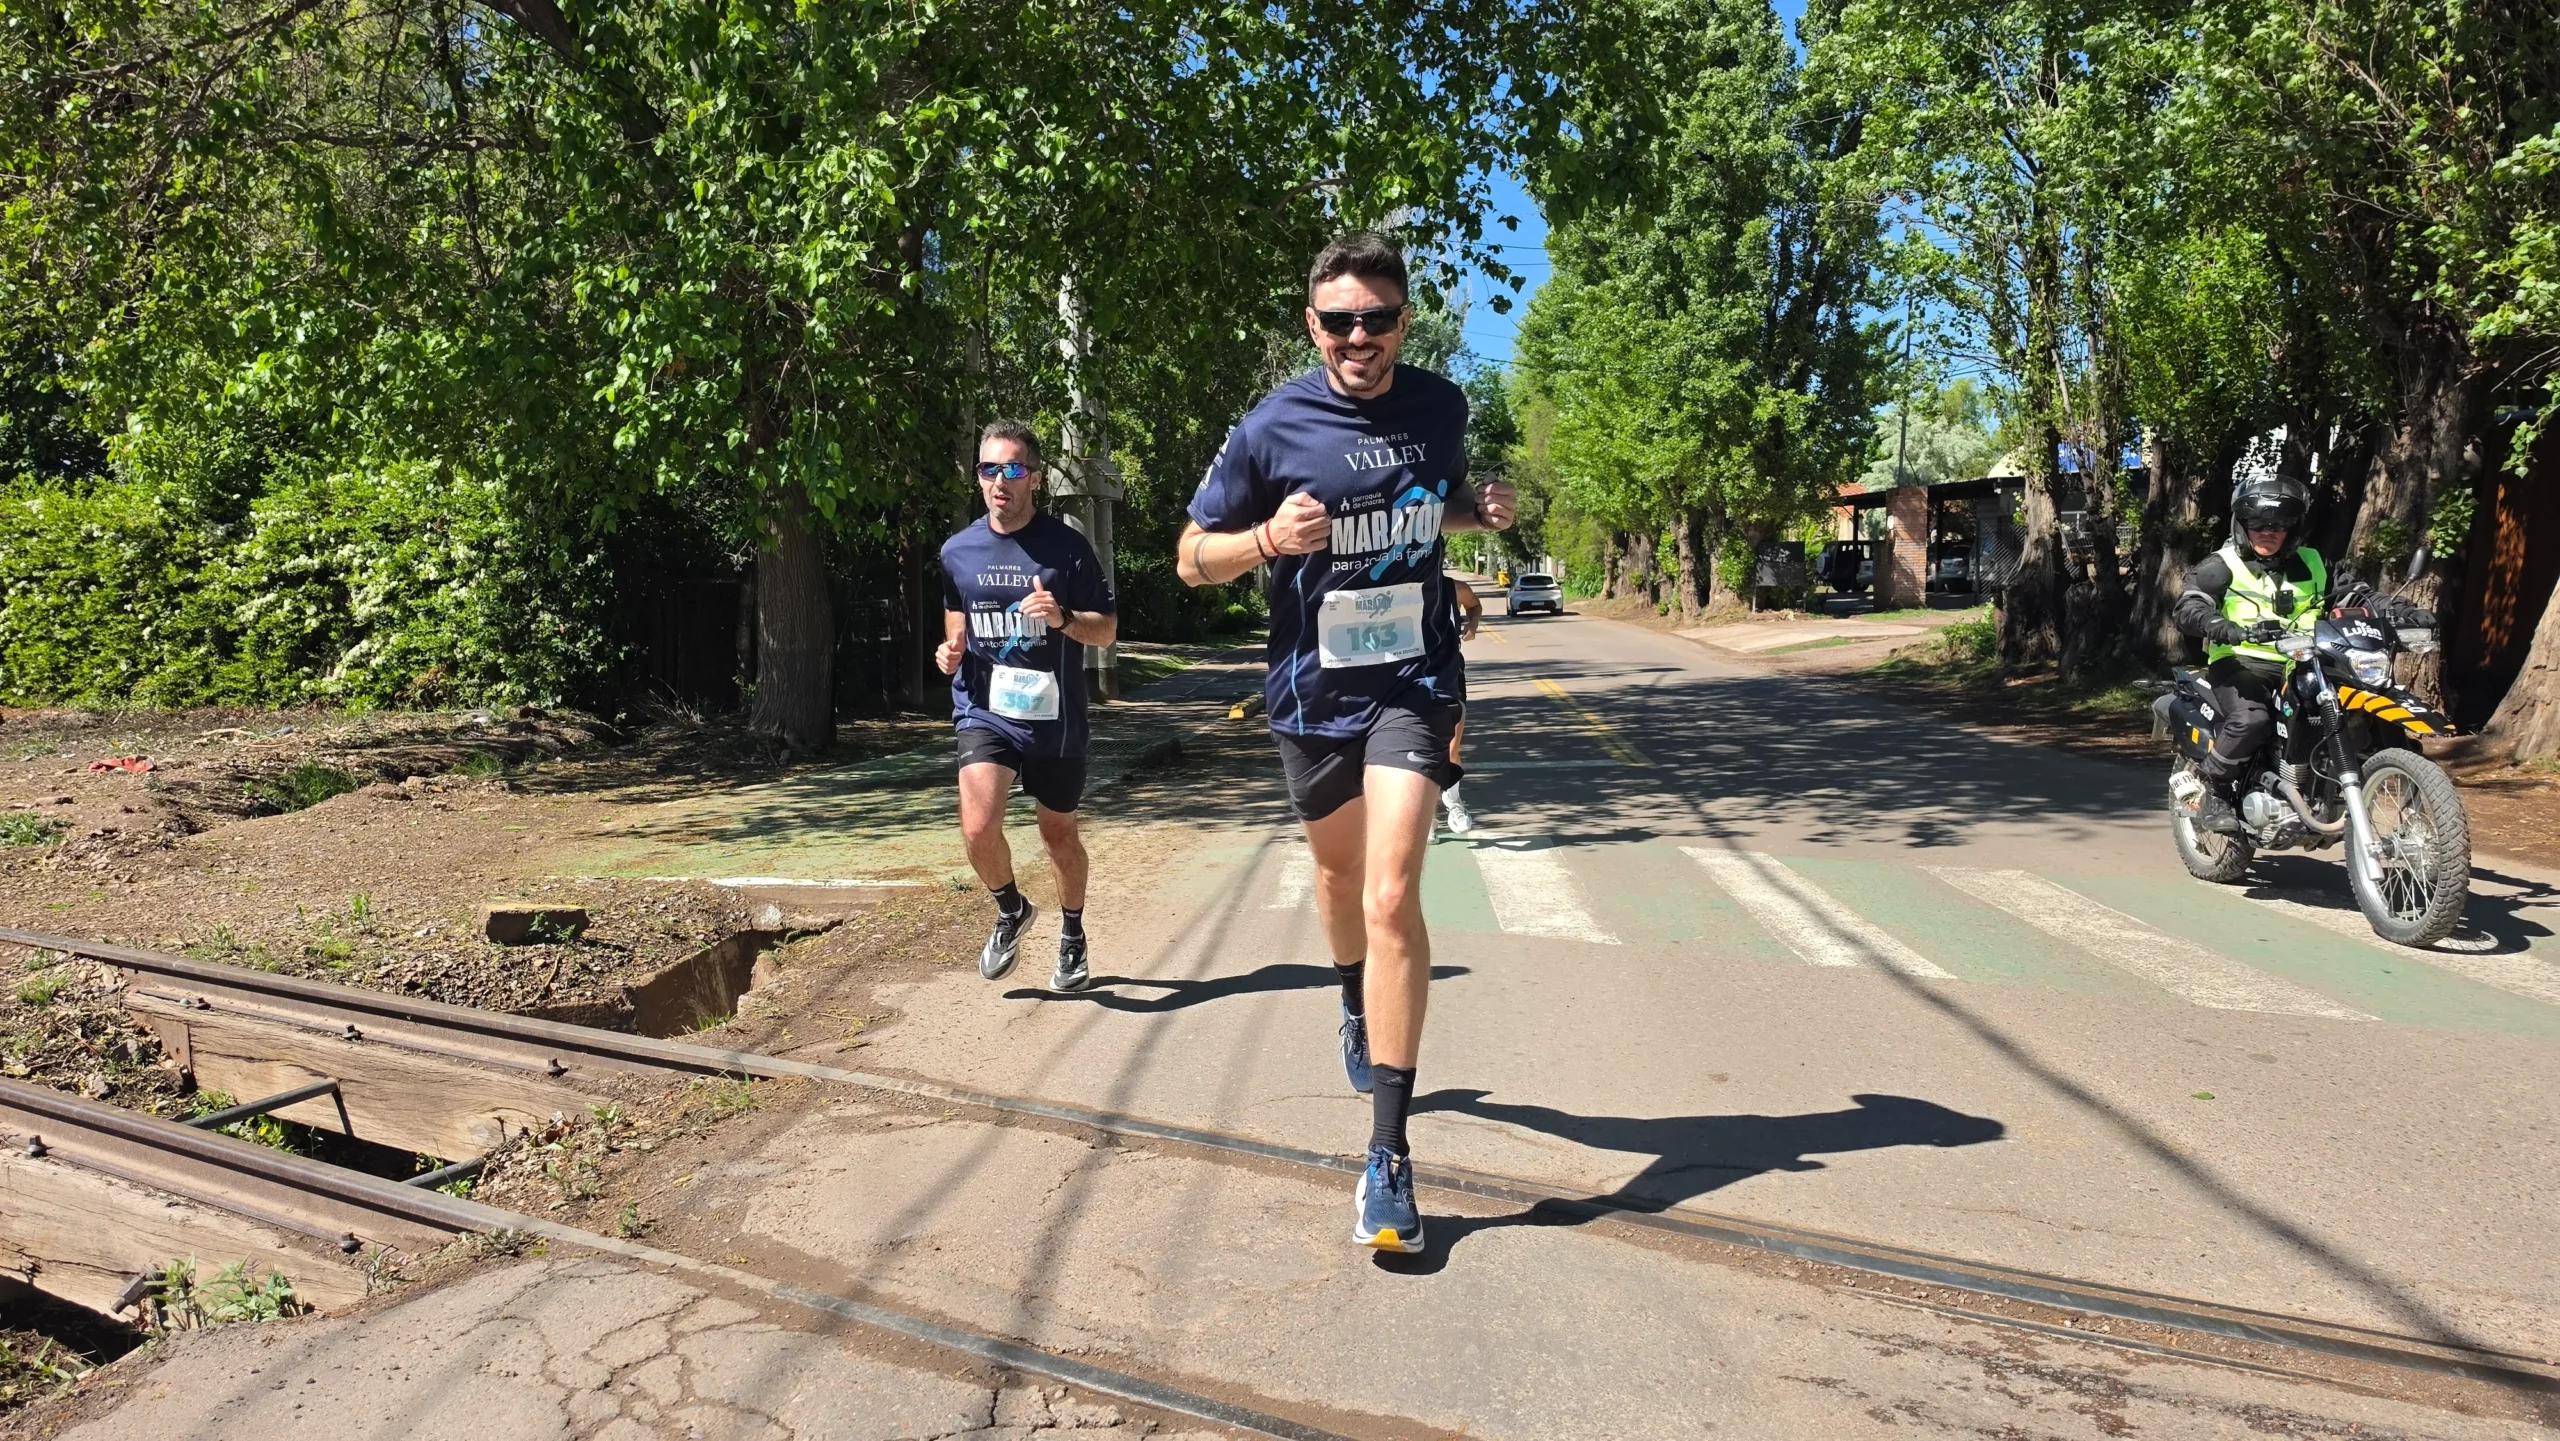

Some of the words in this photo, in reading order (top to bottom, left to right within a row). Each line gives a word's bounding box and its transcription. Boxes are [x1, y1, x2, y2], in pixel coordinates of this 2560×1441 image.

[1357, 432, 1409, 446] PALMARES
[1344, 443, 1427, 472] VALLEY
[1352, 491, 1382, 503] parroquia
[1361, 498, 1385, 508] chacras
[1331, 493, 1445, 555] MARATÓN
[1332, 559, 1362, 573] para
[1393, 549, 1403, 561] la
[976, 573, 1032, 588] VALLEY
[1346, 622, 1398, 652] 163
[2342, 621, 2382, 638] Luján
[1003, 692, 1044, 711] 387
